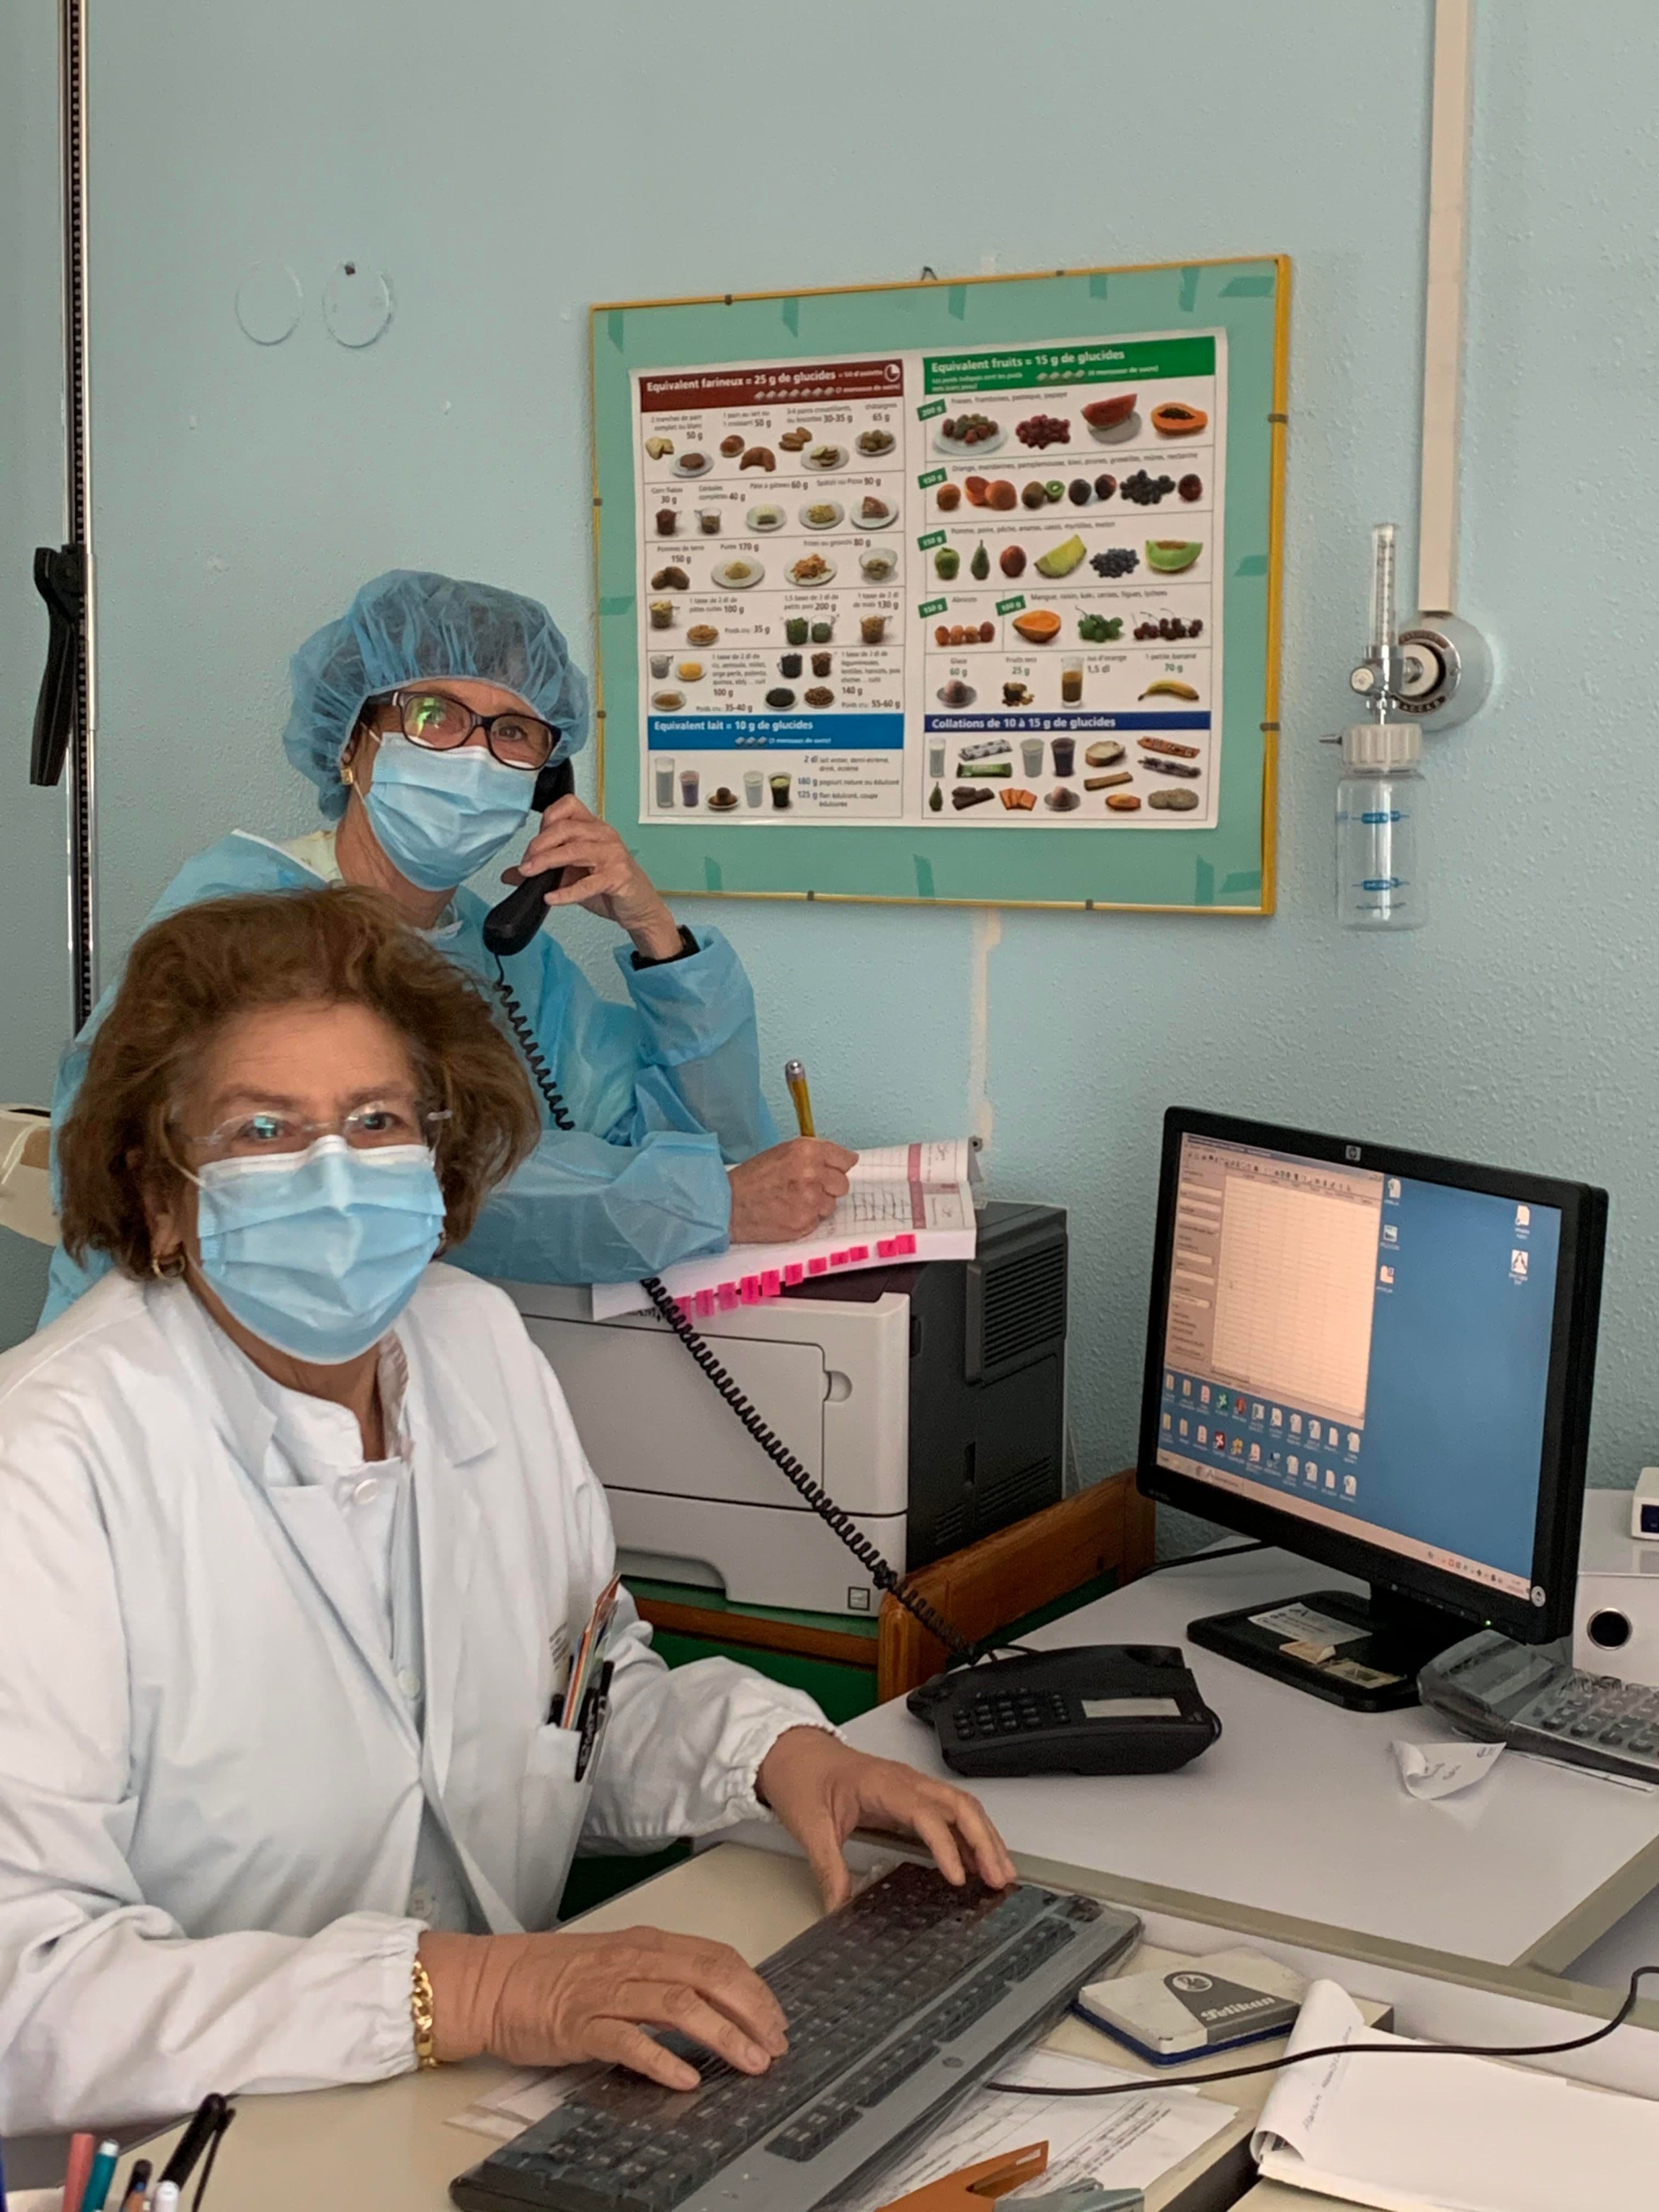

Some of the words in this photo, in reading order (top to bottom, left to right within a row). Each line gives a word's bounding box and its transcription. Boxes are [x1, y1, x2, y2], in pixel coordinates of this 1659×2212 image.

[932, 359, 989, 374] Equivalent
[991, 357, 1023, 368] fruits
[1035, 355, 1048, 365] 15
[1051, 356, 1058, 366] g
[1061, 353, 1075, 363] de
[1077, 350, 1125, 364] glucides
[647, 380, 699, 393] Equivalent
[701, 377, 743, 389] farineux
[754, 374, 767, 385] 25
[769, 375, 776, 386] g
[778, 373, 791, 383] de
[793, 369, 836, 385] glucides
[823, 414, 845, 422] 30-35
[847, 415, 853, 423] g
[698, 432, 703, 441] g
[803, 482, 808, 490] g
[876, 478, 881, 487] g
[672, 497, 677, 505] g
[740, 494, 746, 502] g
[754, 544, 759, 552] g
[865, 539, 871, 548] g
[671, 555, 685, 563] 150
[686, 556, 691, 564] g
[815, 602, 829, 611] 200
[831, 603, 836, 612] g
[878, 600, 891, 608] 130
[893, 601, 899, 610] g
[739, 606, 744, 614] g
[754, 625, 763, 633] 35
[765, 626, 770, 635] g
[1012, 667, 1022, 675] 25
[1024, 667, 1030, 676] g
[1088, 665, 1099, 673] 1,5
[1102, 664, 1110, 673] dl
[1165, 663, 1174, 672] 70
[1176, 664, 1183, 673] g
[950, 668, 960, 676] 60
[962, 668, 967, 678] g
[728, 689, 733, 698] g
[857, 687, 862, 696] g
[725, 704, 746, 712] 35-40
[747, 704, 753, 713] g
[871, 699, 893, 708] 55-60
[895, 700, 900, 709] g
[654, 721, 705, 731] Equivalent
[707, 721, 724, 730] lait
[735, 721, 747, 730] 10
[748, 723, 755, 732] g
[758, 721, 770, 730] de
[772, 720, 813, 731] glucides
[932, 718, 985, 730] Collations
[988, 718, 1000, 728] de
[1004, 718, 1016, 728] 10
[1018, 716, 1025, 727] à
[1028, 718, 1040, 728] 15
[1043, 720, 1051, 730] g
[1053, 717, 1067, 727] de
[1070, 717, 1115, 730] glucides
[812, 778, 817, 787] g
[812, 792, 817, 800] g
[1201, 1997, 1276, 2021] Pelikan
